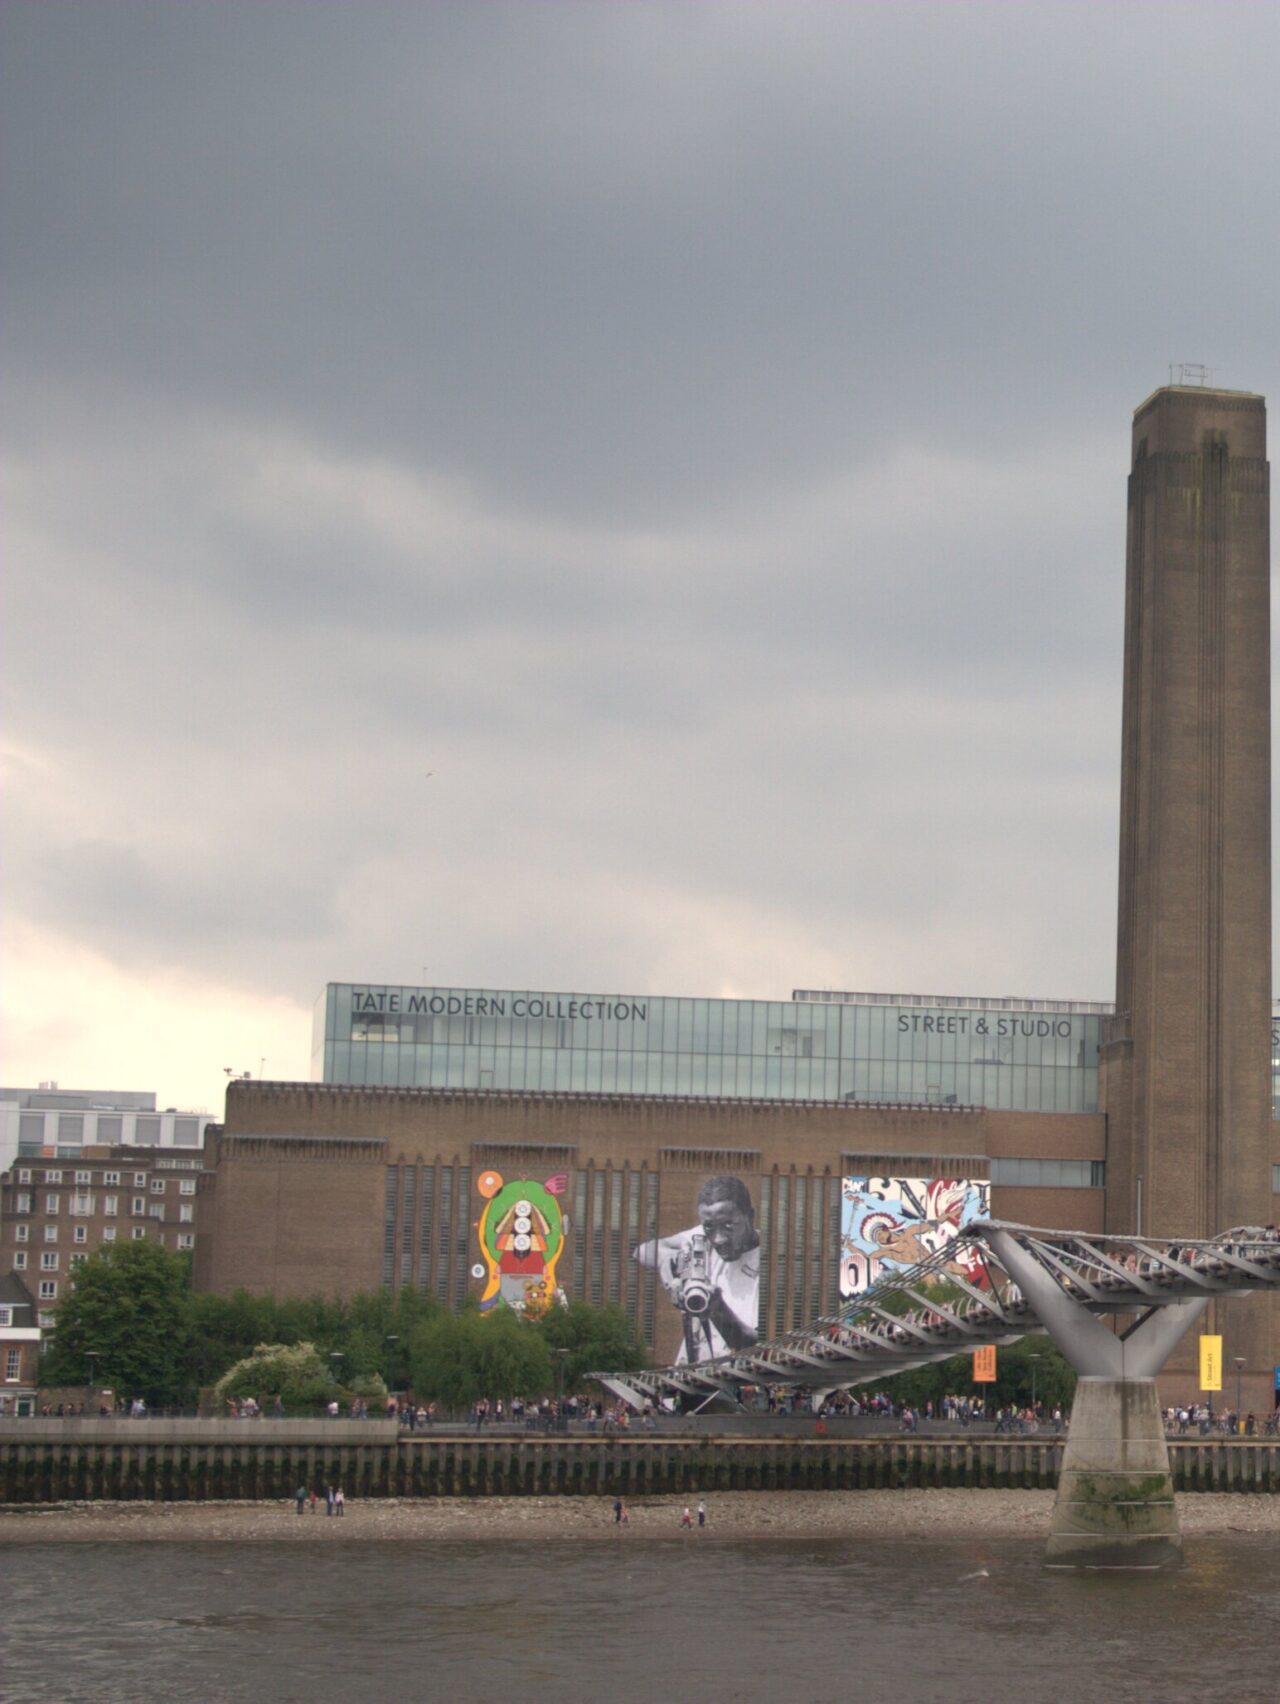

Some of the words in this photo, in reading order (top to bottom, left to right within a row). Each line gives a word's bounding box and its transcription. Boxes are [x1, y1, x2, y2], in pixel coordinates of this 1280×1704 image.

[353, 991, 400, 1012] TATE
[408, 994, 506, 1017] MODERN
[512, 998, 647, 1021] COLLECTION
[897, 1014, 969, 1035] STREET
[975, 1017, 989, 1035] &
[997, 1018, 1072, 1039] STUDIO
